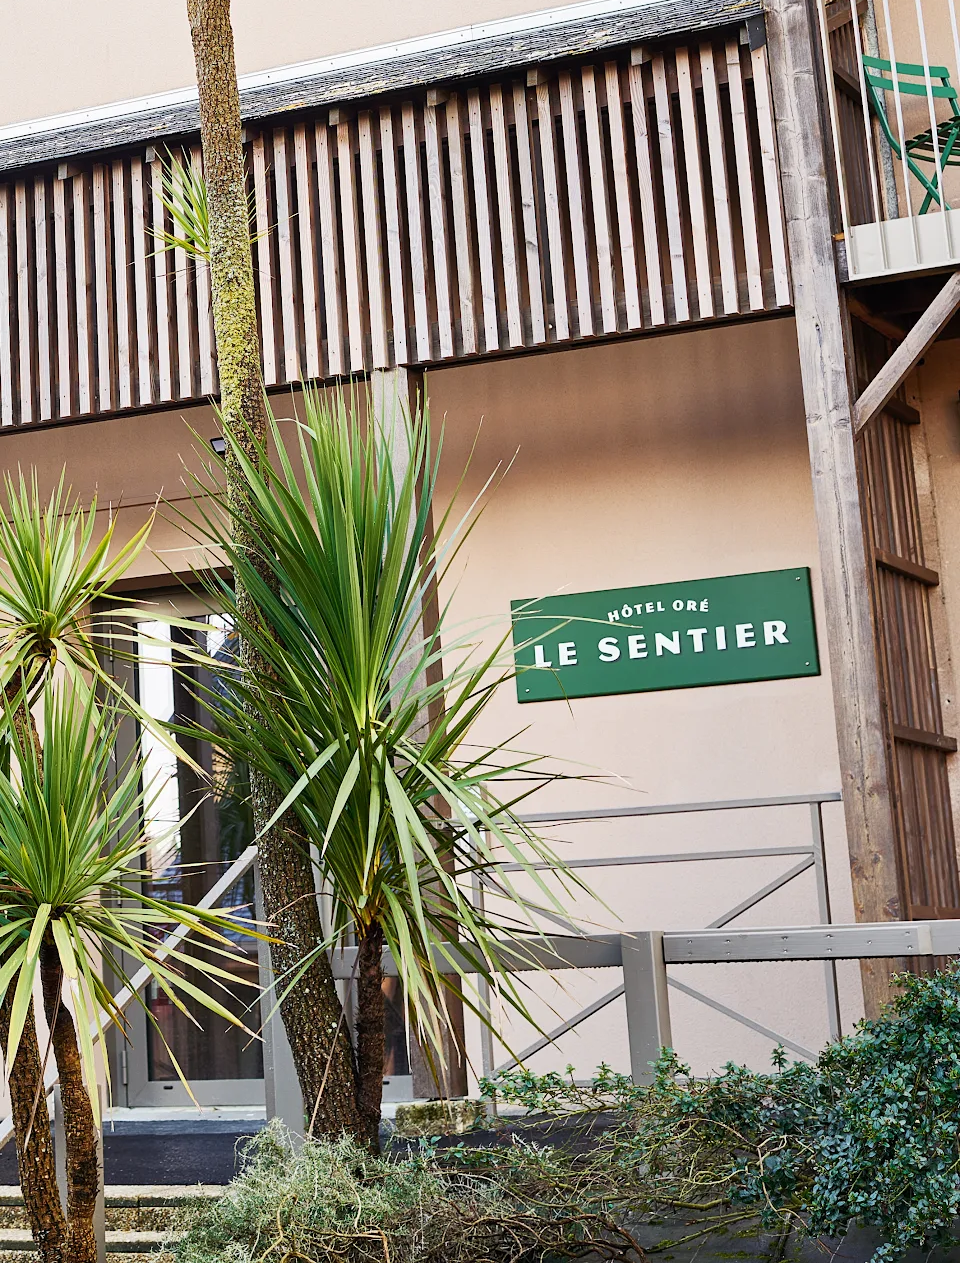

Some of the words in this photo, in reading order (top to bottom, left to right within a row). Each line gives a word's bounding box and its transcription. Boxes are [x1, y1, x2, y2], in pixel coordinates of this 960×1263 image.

[607, 600, 665, 623] HÔTEL
[672, 598, 710, 613] ORÉ
[534, 641, 578, 668] LE
[597, 620, 790, 663] SENTIER
